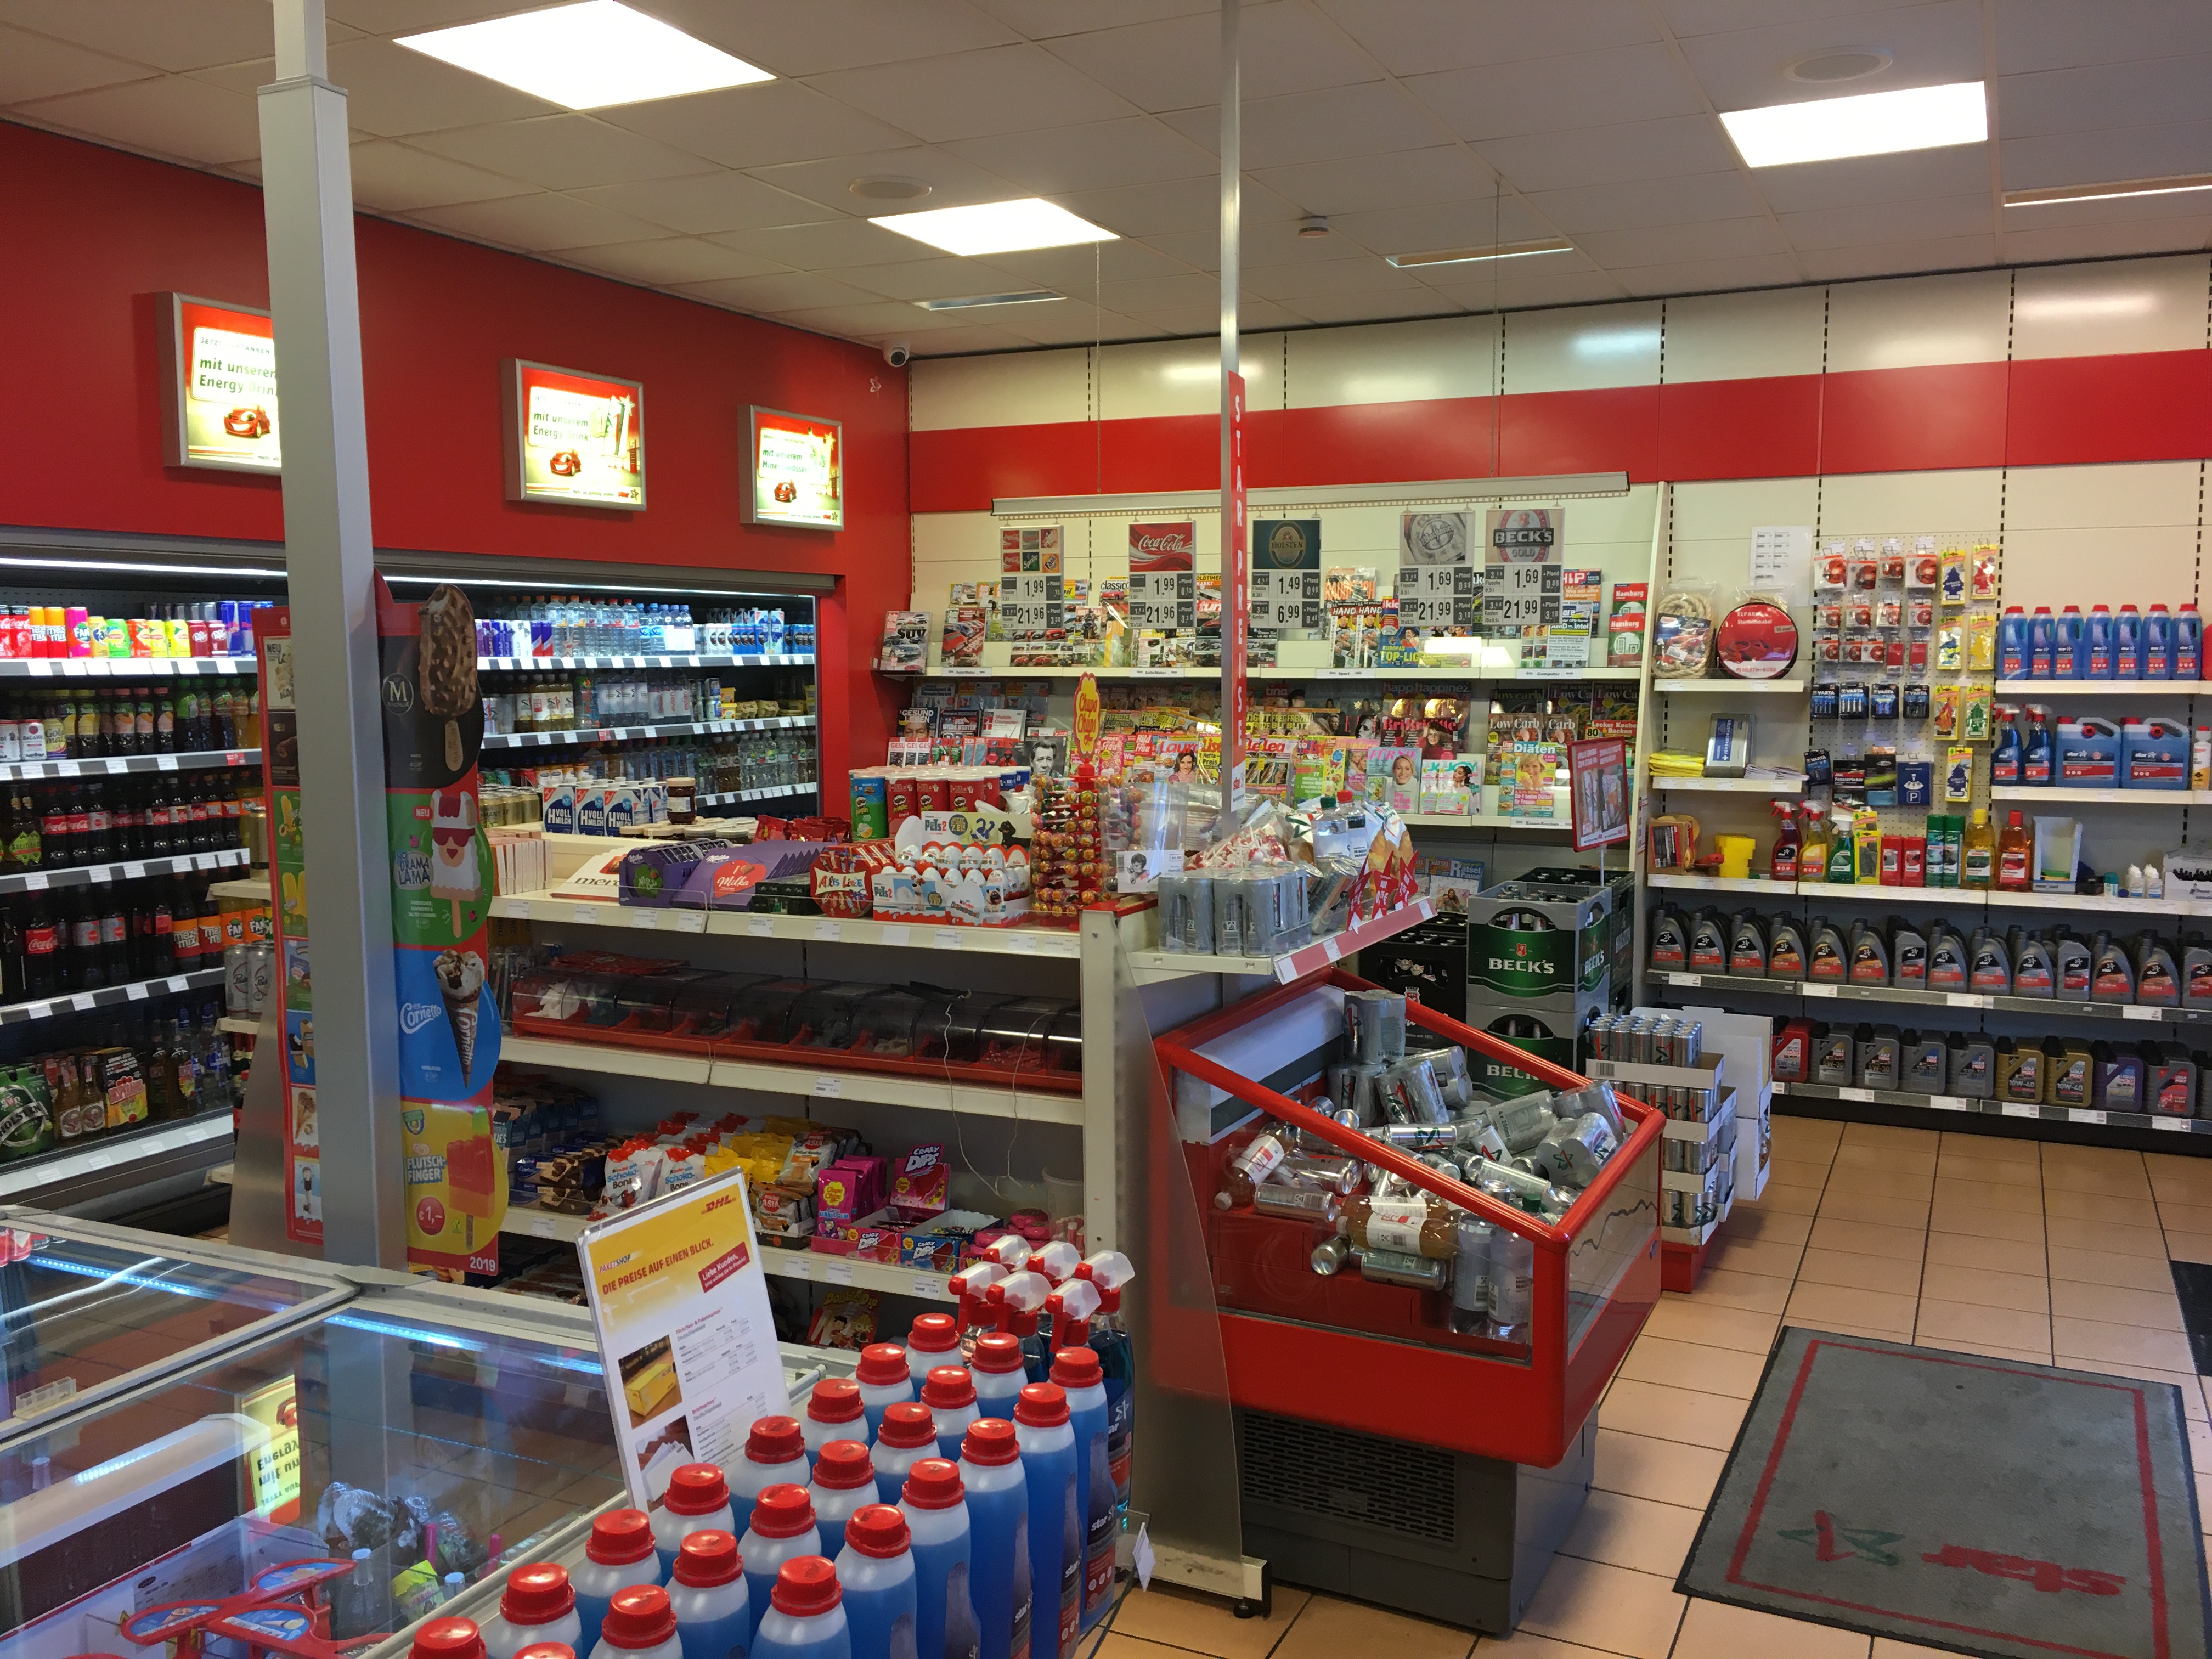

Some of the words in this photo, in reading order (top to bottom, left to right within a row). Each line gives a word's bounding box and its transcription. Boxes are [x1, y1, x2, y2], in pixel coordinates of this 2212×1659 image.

[200, 357, 222, 371] mit
[199, 374, 244, 394] Energy
[534, 412, 549, 422] mit
[552, 416, 588, 427] unserem
[533, 425, 562, 440] Energy
[763, 448, 774, 457] mit
[776, 452, 803, 461] unserem
[1495, 529, 1553, 544] BECK'S
[1511, 549, 1536, 557] GOLD
[1279, 576, 1300, 594] 1.49
[1428, 572, 1451, 590] 1.69
[1514, 569, 1539, 588] 1.69
[1025, 579, 1044, 597] 1.99
[1155, 578, 1175, 595] 1.99
[1018, 607, 1045, 624] 21.96
[1147, 606, 1175, 624] 21.96
[1278, 605, 1300, 623] 6.99
[1419, 602, 1451, 620] 21.99
[1504, 600, 1538, 619] 21.99
[897, 629, 927, 639] SUV
[266, 644, 282, 654] NEU
[388, 680, 408, 702] M
[1266, 687, 1288, 696] tina
[1489, 719, 1511, 729] Low
[1514, 718, 1540, 729] Carb
[1548, 718, 1576, 730] Carb
[1136, 733, 1152, 743] Bild
[1587, 729, 1599, 737] 80
[1135, 744, 1152, 753] Frau
[1263, 740, 1285, 753] Lea
[1514, 741, 1556, 754] Diäten
[1369, 748, 1395, 760] FÜR
[1909, 792, 1918, 801] P
[416, 808, 430, 817] NEU
[556, 809, 571, 817] VOLL
[588, 810, 603, 819] VOLL
[616, 812, 631, 821] VOLL
[588, 819, 603, 827] MILCH
[941, 821, 946, 832] 2
[399, 857, 430, 872] DRAMA
[706, 854, 730, 864] Milka
[398, 868, 431, 885] LAMA
[716, 876, 749, 887] Milka
[888, 888, 893, 898] 2
[1488, 957, 1555, 974] BECK'S
[1584, 949, 1605, 975] BECK'S
[400, 1002, 442, 1035] Cornetto
[457, 1007, 478, 1065] Cornetto
[806, 1138, 822, 1147] ASIA
[913, 1146, 941, 1155] CRAZY
[407, 1155, 447, 1170] FLUTSCH-
[905, 1152, 940, 1173] DIPS
[408, 1167, 441, 1182] FINGER
[612, 1178, 633, 1189] Bons
[706, 1195, 731, 1212] DHL
[762, 1199, 780, 1209] ASIA
[857, 1237, 879, 1250] DIPS
[913, 1245, 935, 1259] DIPS
[470, 1256, 496, 1272] 2019
[599, 1254, 631, 1273] PAKETSHOP
[602, 1280, 617, 1295] DIE
[618, 1267, 648, 1289] PREISE
[648, 1259, 664, 1275] AUF
[665, 1250, 690, 1267] EINEN
[689, 1238, 714, 1255] BLICK.
[702, 1265, 718, 1281] Liebe
[716, 1254, 738, 1271] Kunden,
[1091, 1516, 1108, 1532] star
